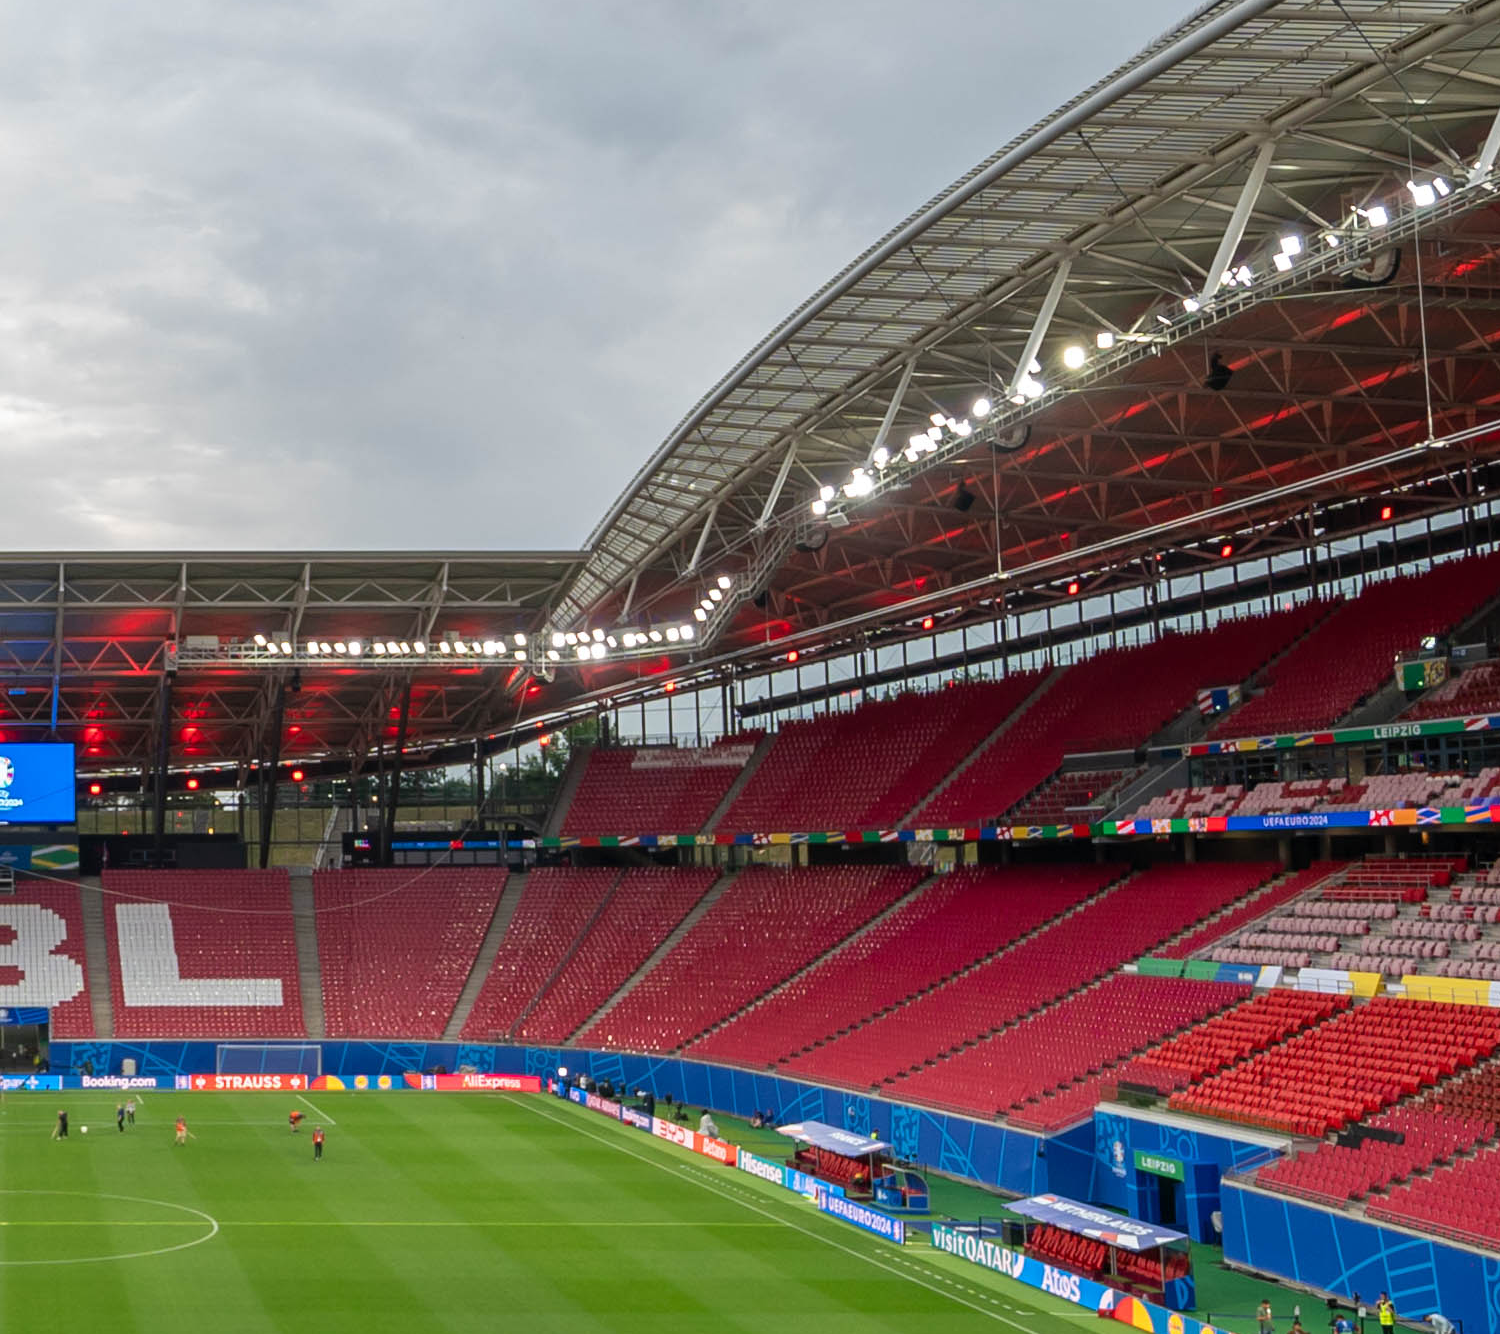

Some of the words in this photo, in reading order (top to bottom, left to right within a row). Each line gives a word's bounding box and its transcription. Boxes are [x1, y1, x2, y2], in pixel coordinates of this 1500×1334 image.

[1373, 724, 1422, 739] LEIPZIG
[82, 1076, 156, 1091] Booking.com
[215, 1076, 282, 1090] STRAUSS
[462, 1074, 521, 1090] AliExpress
[741, 1151, 783, 1184] Hisense
[1141, 1156, 1176, 1174] LEIPZIG
[1052, 1202, 1153, 1236] NETHERLANDS
